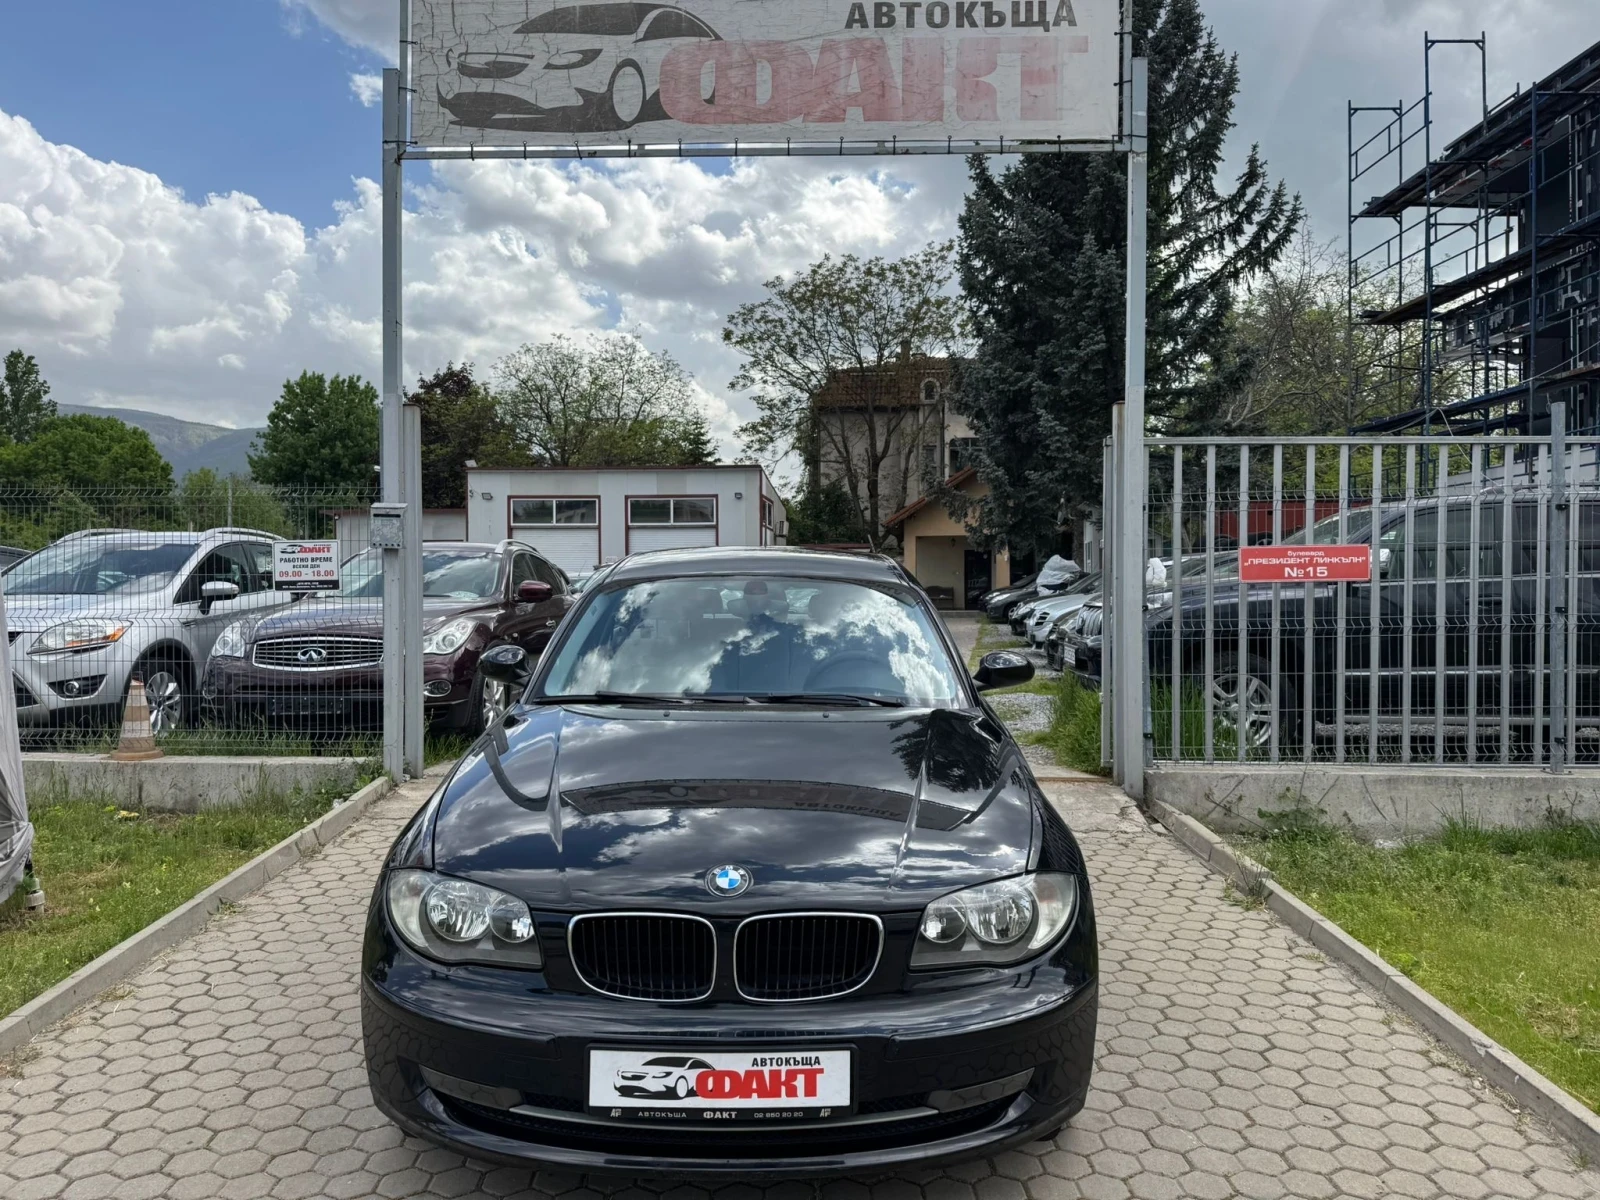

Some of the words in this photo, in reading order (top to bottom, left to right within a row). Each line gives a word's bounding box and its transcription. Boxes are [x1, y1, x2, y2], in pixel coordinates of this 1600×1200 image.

[844, 0, 1078, 32] АВТОКЪЩА
[659, 36, 1089, 125] ФАКТ
[312, 569, 334, 577] 18.00
[751, 1056, 821, 1067] АВТОКЪЩА
[695, 1068, 824, 1099] ФАКТ
[703, 1111, 738, 1119] ФАКТ
